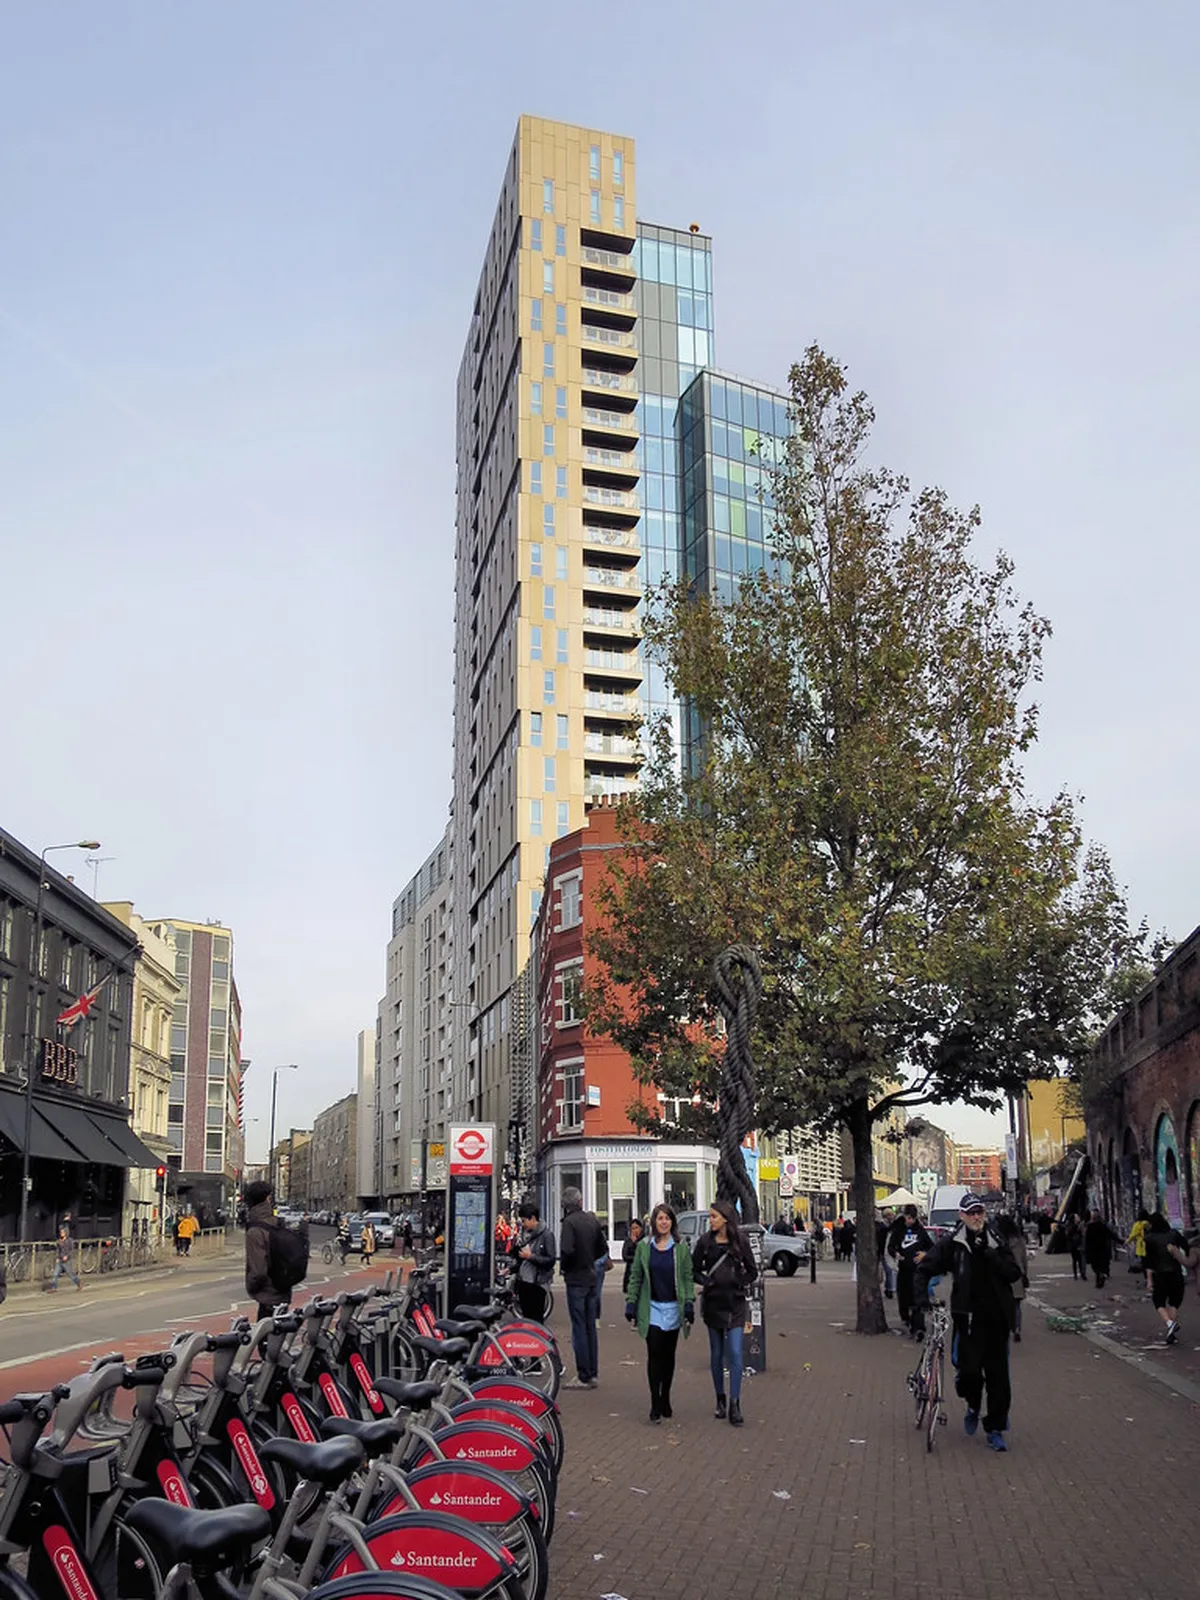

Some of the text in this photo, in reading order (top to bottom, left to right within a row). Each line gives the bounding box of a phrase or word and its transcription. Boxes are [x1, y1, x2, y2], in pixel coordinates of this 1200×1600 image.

[42, 1038, 78, 1083] BBB
[240, 1443, 257, 1475] Santander
[467, 1446, 517, 1458] Santander
[443, 1492, 502, 1506] Santander
[406, 1551, 478, 1567] Santander
